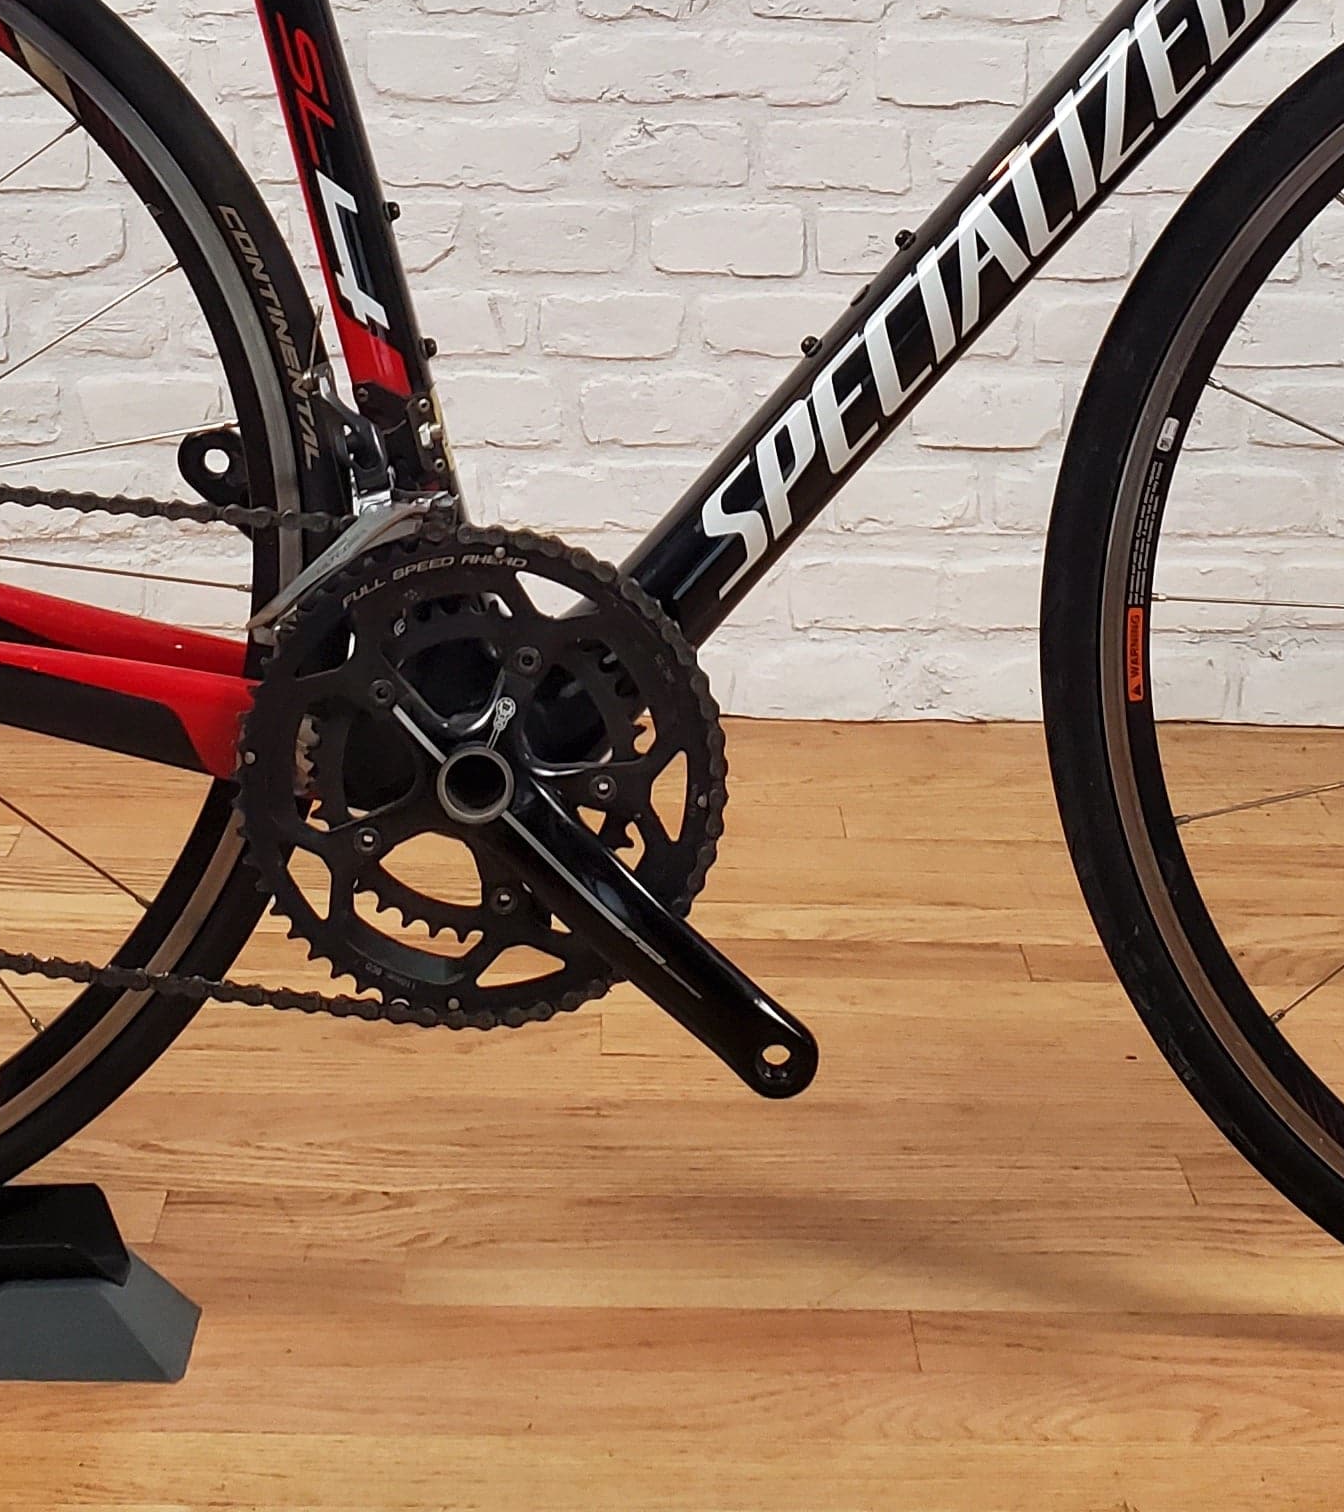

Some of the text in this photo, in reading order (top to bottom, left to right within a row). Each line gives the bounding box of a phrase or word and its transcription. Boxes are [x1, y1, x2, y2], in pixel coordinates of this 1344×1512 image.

[218, 203, 321, 473] CONTINENTAL
[341, 577, 386, 609] FULL
[391, 555, 455, 581] SPEED
[1129, 614, 1142, 678] WARNING
